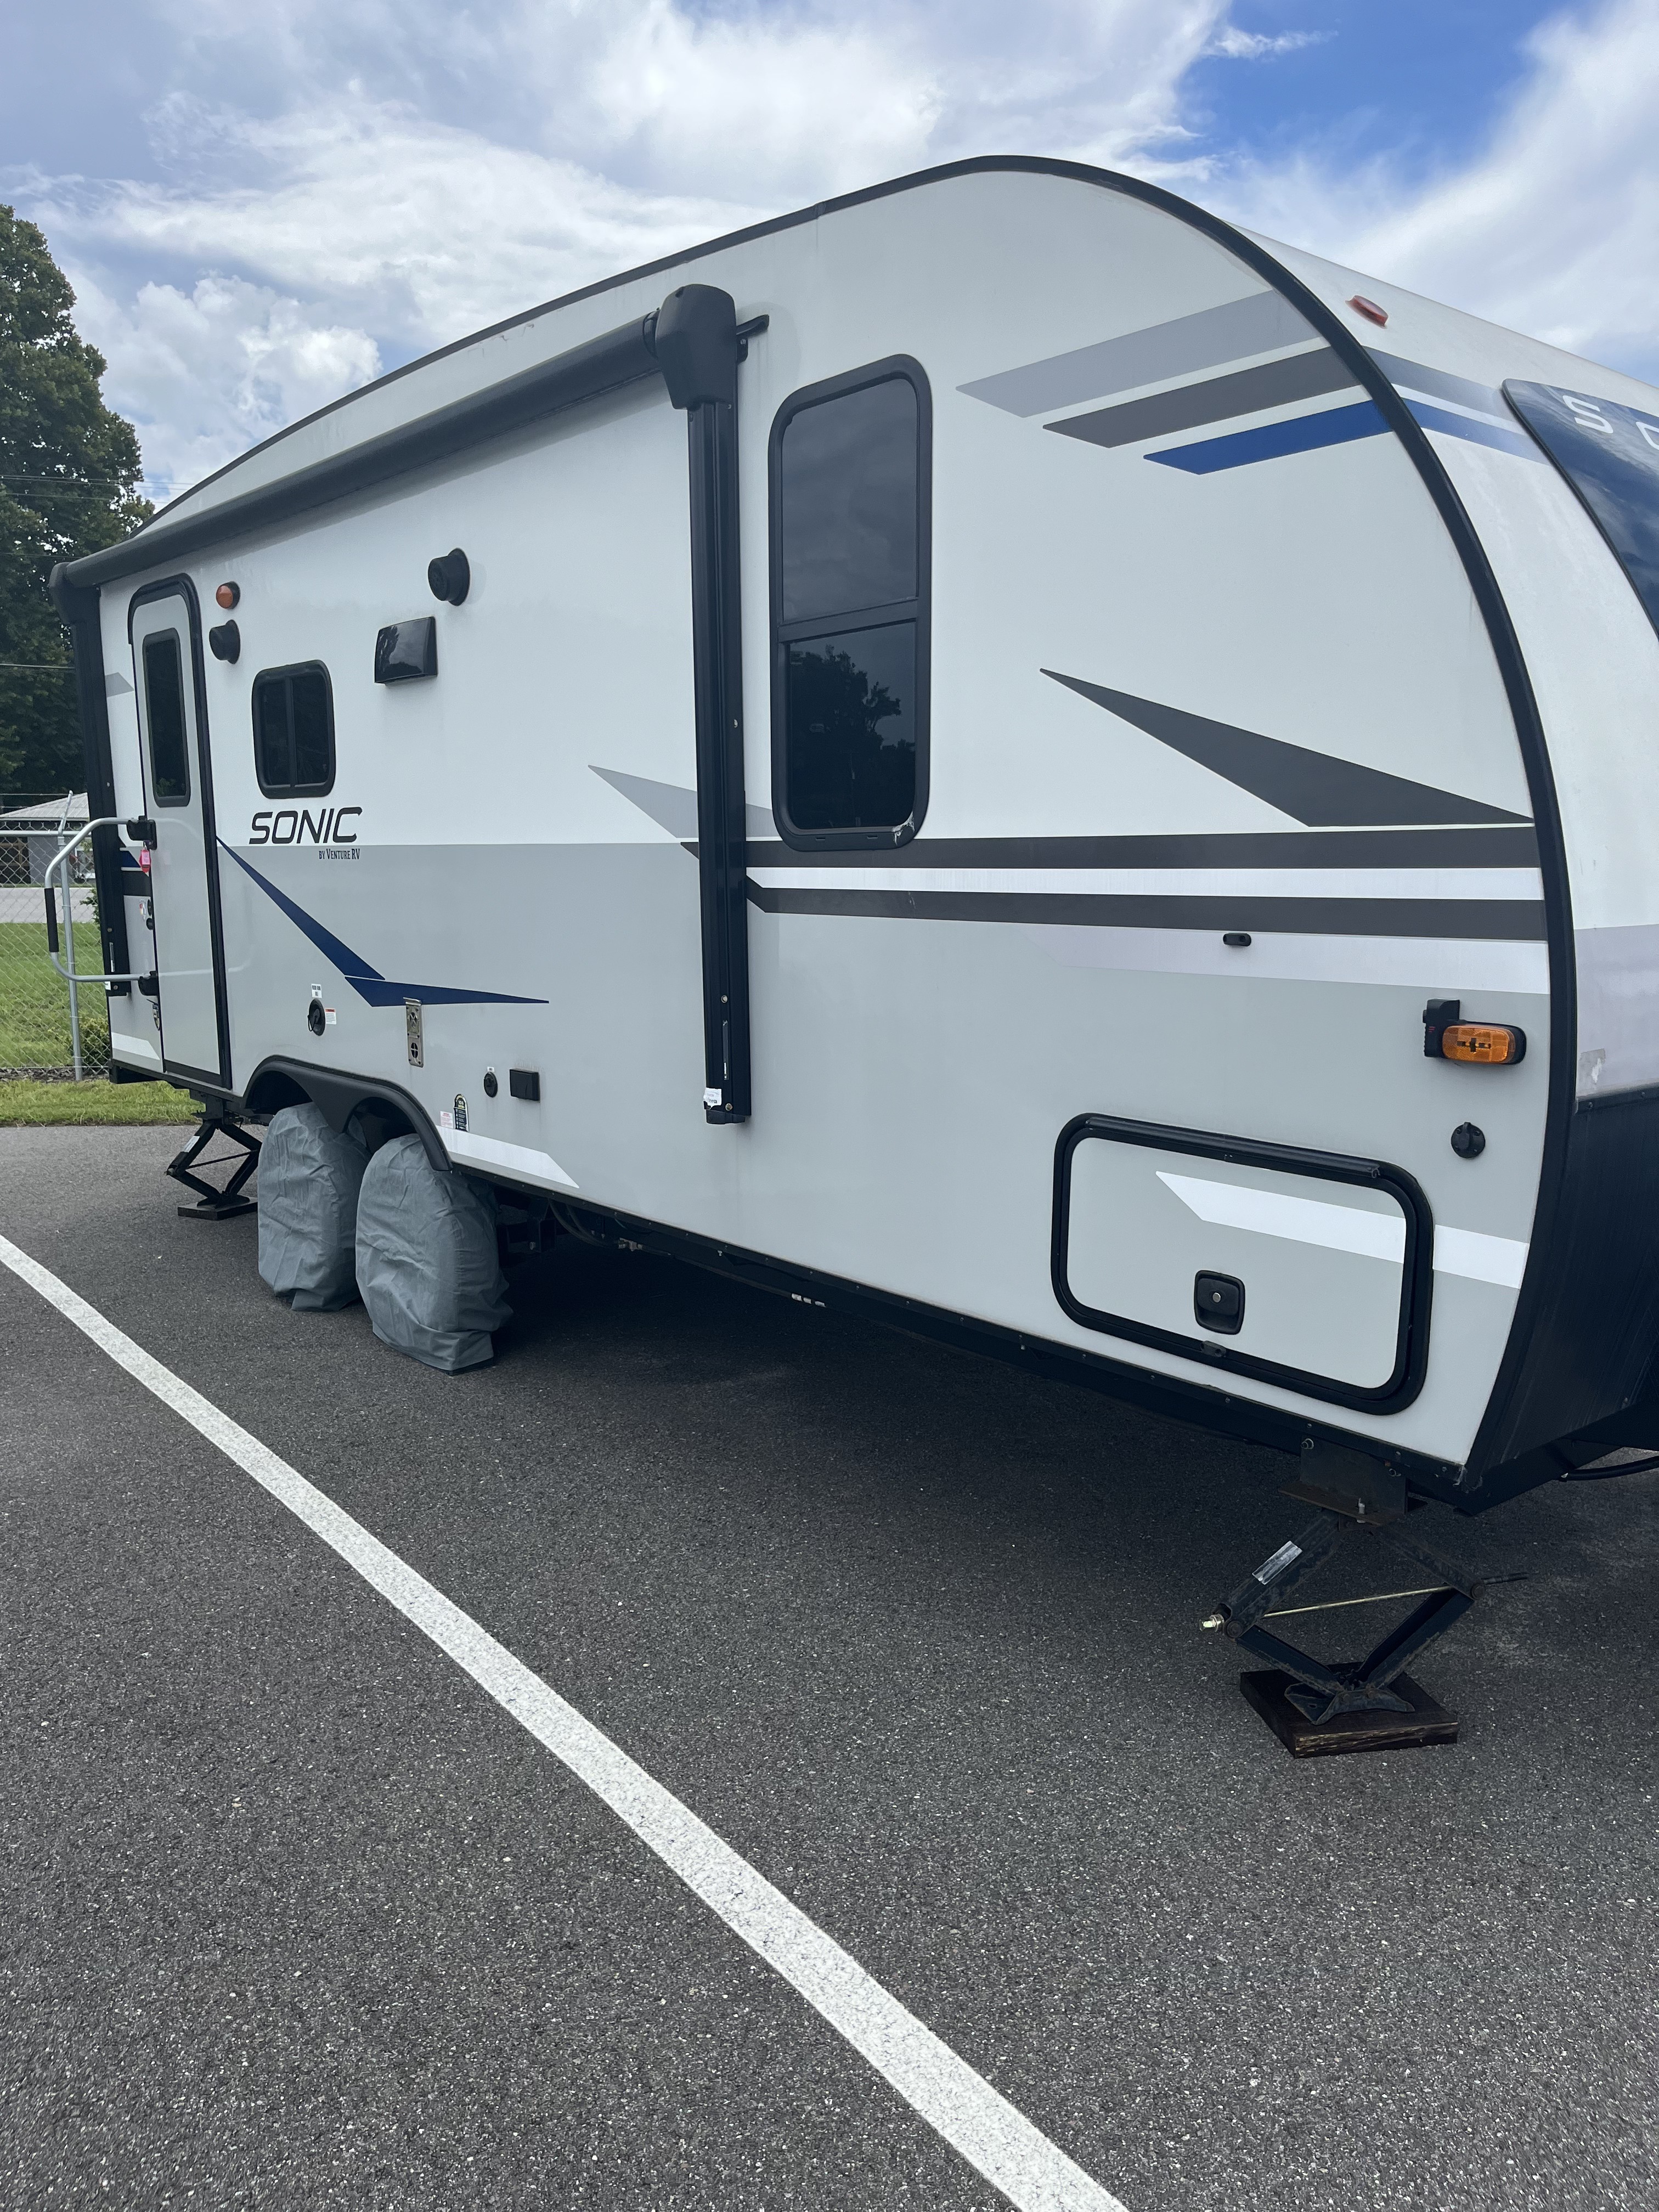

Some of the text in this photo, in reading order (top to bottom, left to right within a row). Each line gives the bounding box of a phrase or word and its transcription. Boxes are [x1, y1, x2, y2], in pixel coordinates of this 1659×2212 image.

[249, 806, 363, 844] SONIC
[319, 848, 360, 860] BY VENTURE RV
